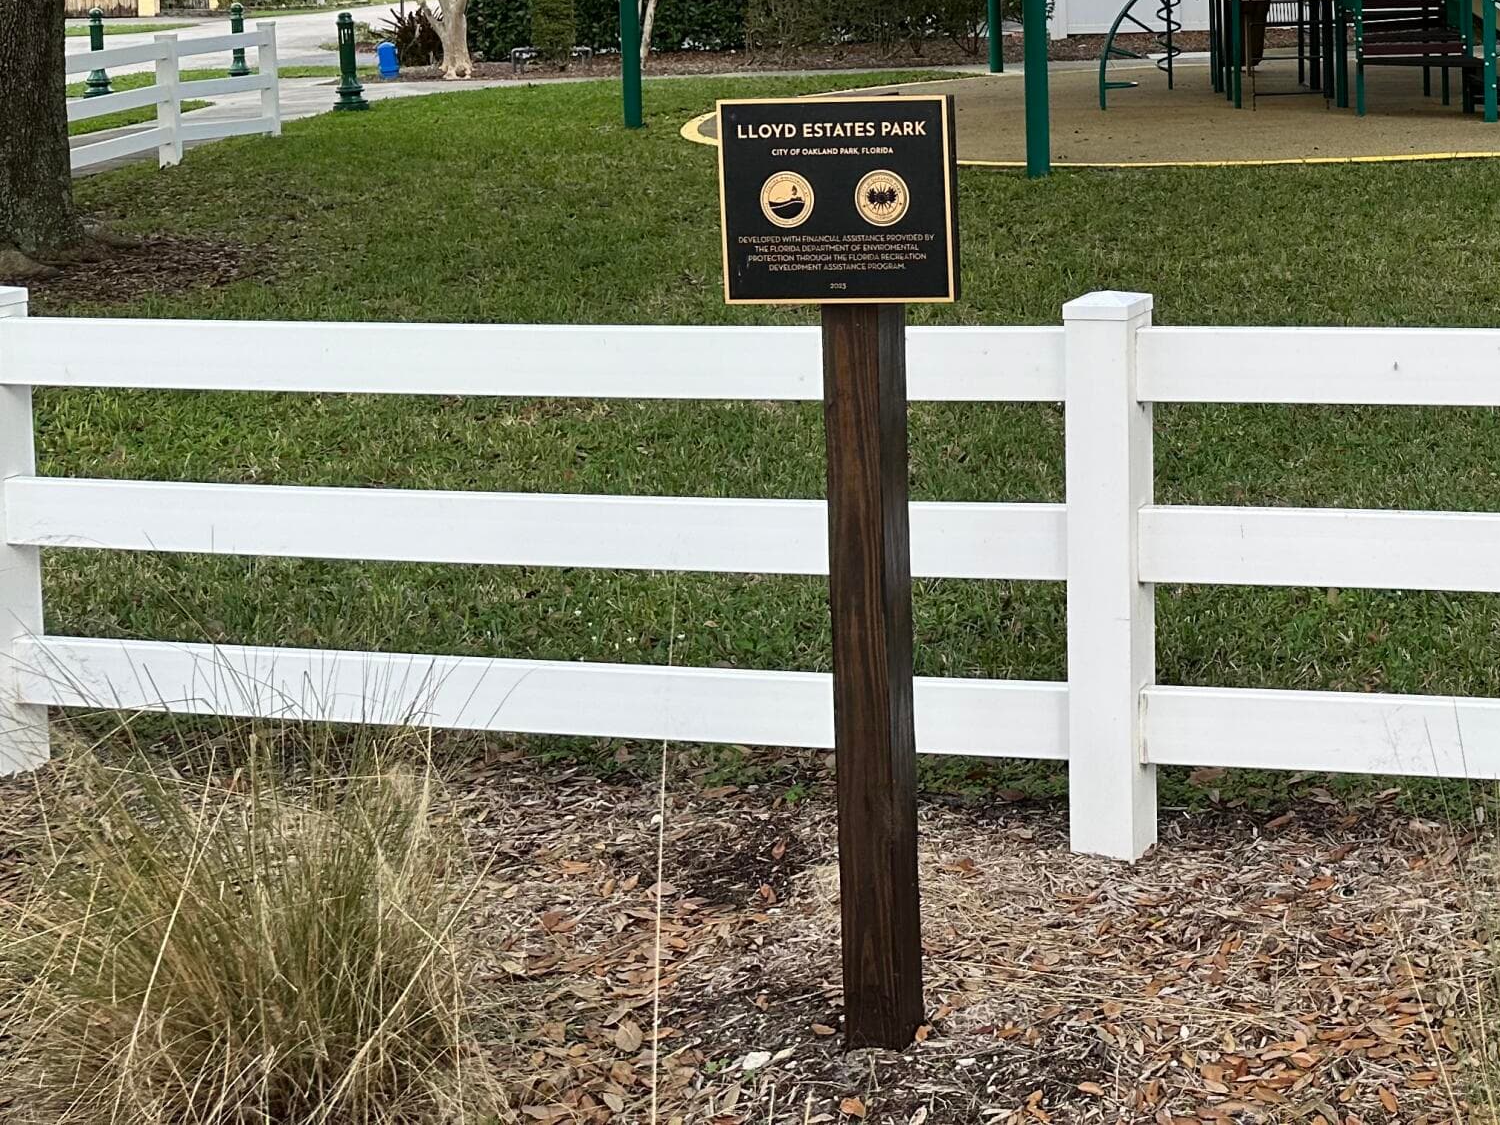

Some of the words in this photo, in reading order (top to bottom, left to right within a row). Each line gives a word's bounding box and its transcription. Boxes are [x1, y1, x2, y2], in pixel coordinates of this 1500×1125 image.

[737, 124, 797, 139] LLOYD
[803, 122, 875, 138] ESTATES
[881, 121, 927, 137] PARK
[771, 148, 788, 156] CITY
[790, 148, 800, 156] OF
[801, 147, 838, 155] OAKLAND
[862, 146, 894, 154] FLORIDA
[738, 236, 781, 244] DEVELOPED
[781, 235, 801, 243] WITH
[842, 234, 885, 242] ASSISTANCE
[886, 234, 923, 242] PROVIDED
[924, 233, 935, 241] BY
[755, 245, 769, 253] THE
[770, 245, 801, 253] FLORIDA
[802, 244, 849, 252] DEPARTMENT
[850, 244, 861, 252] OF
[748, 254, 795, 262] PROTECTION
[795, 254, 832, 262] THROUGH
[848, 253, 880, 261] FLORIDA
[880, 252, 927, 261] RECREATION
[768, 263, 822, 271] DEVELOPMENT
[823, 263, 866, 271] ASSISTANCE
